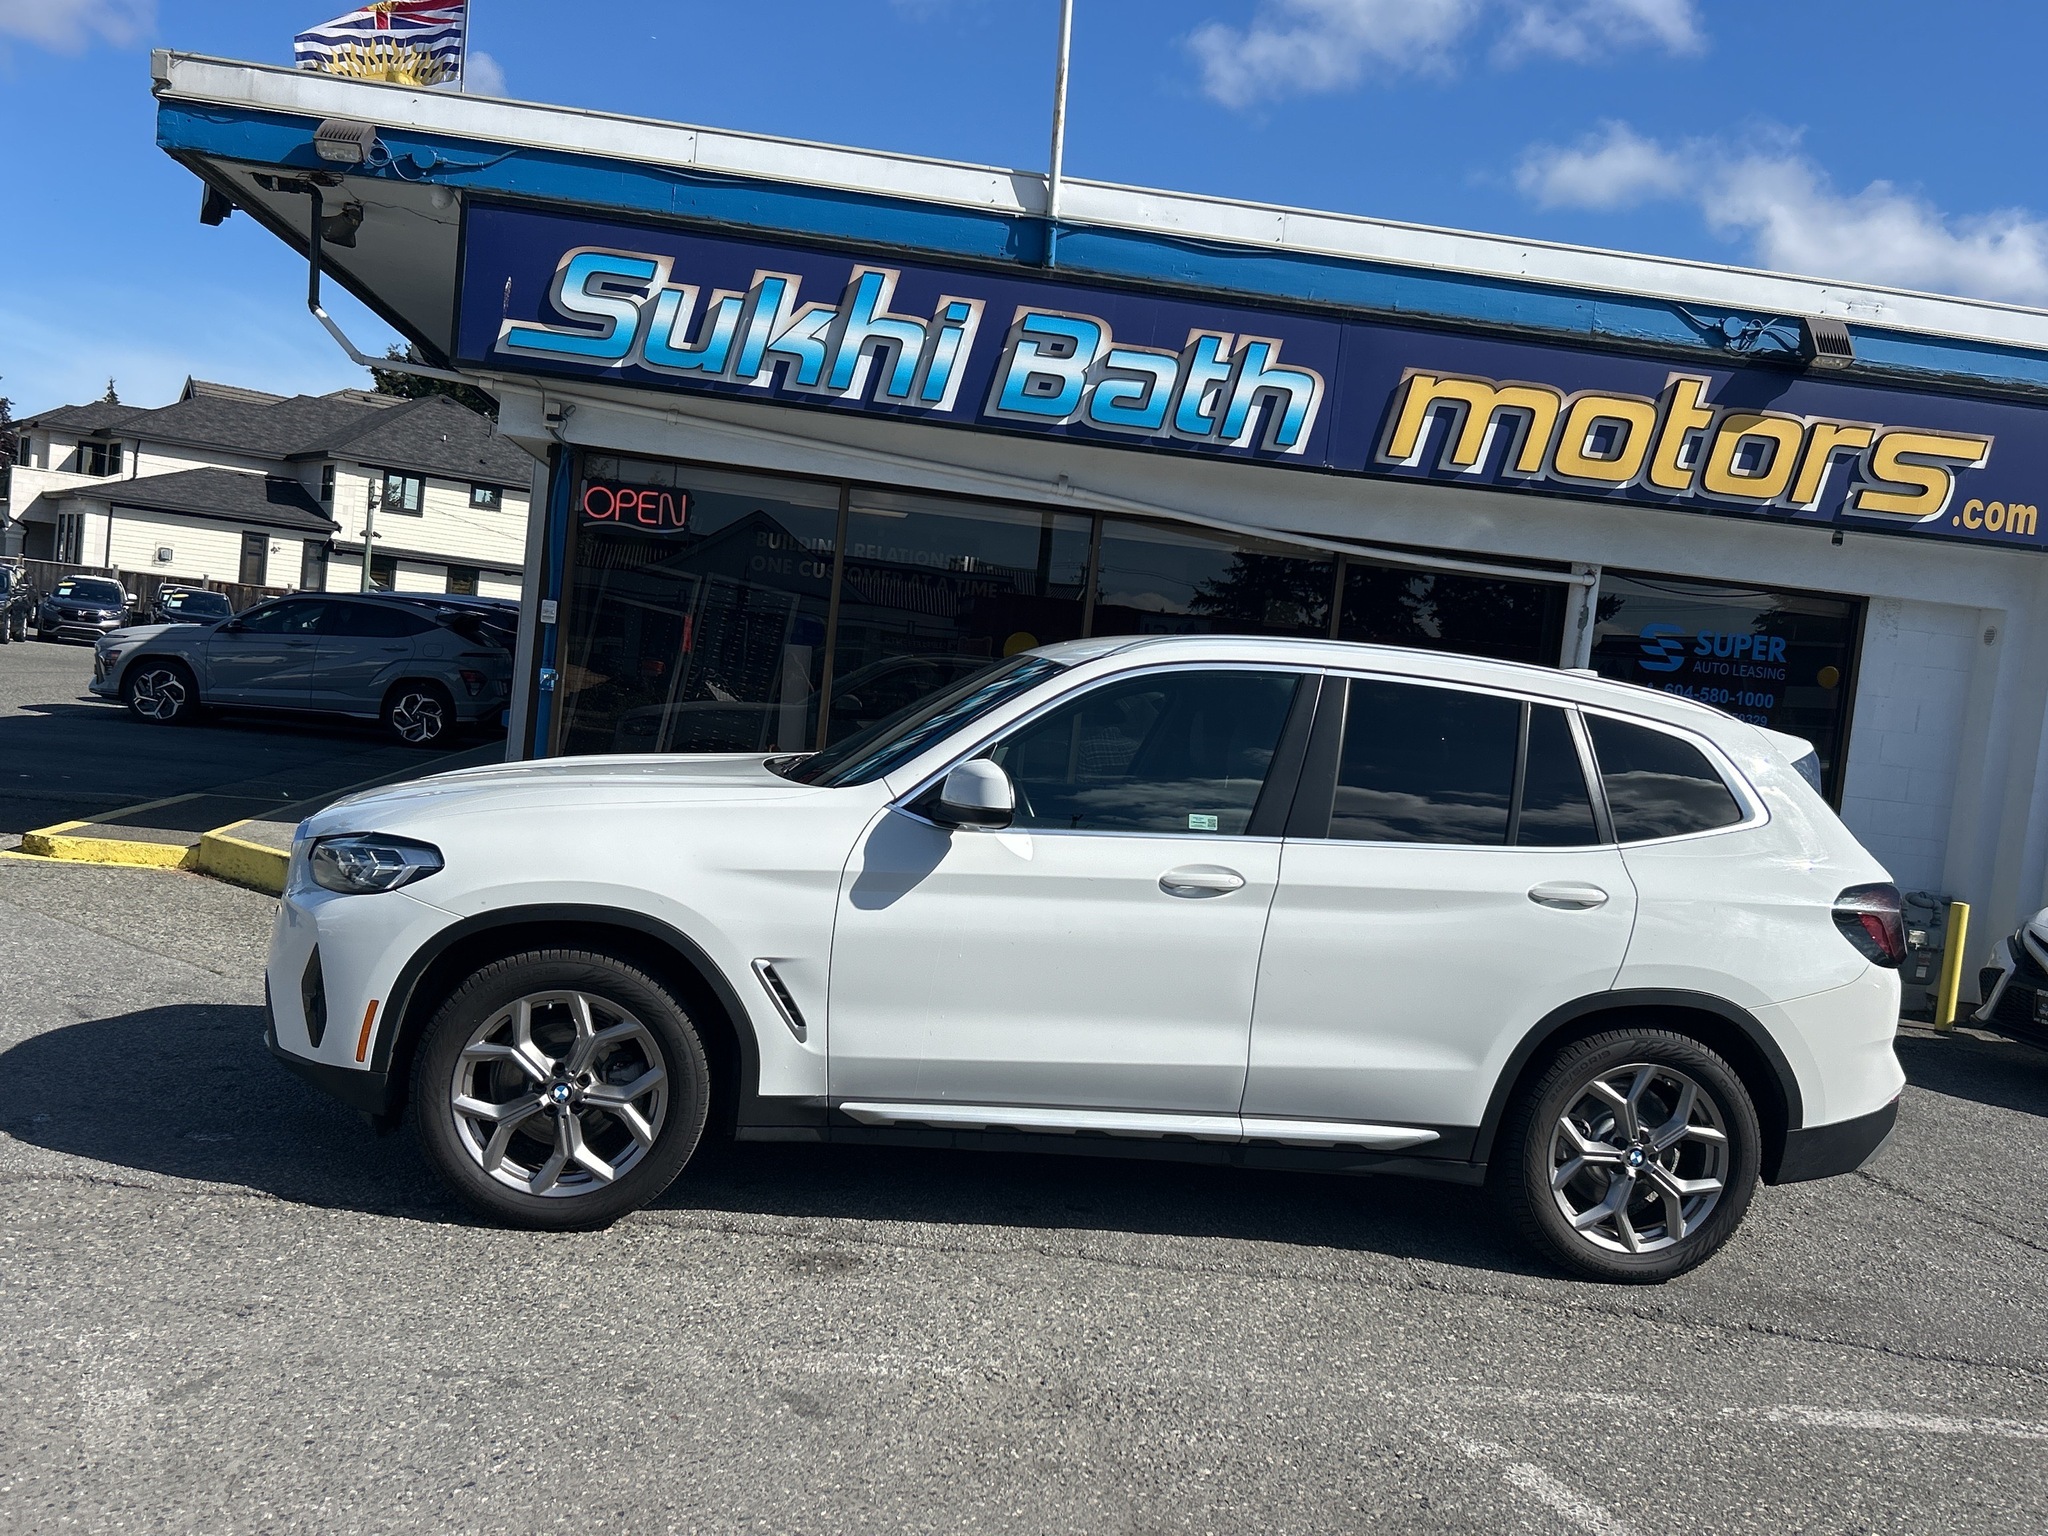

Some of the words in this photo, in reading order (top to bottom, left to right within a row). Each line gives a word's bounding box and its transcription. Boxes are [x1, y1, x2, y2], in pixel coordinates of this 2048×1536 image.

[496, 246, 985, 410] Sukhi
[985, 306, 1325, 454] Bath
[1374, 367, 1994, 522] motors
[1952, 499, 2038, 536] .com
[584, 486, 687, 527] OPEN
[751, 555, 793, 576] ONE
[955, 579, 998, 599] TIME
[1694, 630, 1788, 664] SUPER
[1693, 660, 1729, 676] AUTO
[1732, 664, 1786, 681] LEASING
